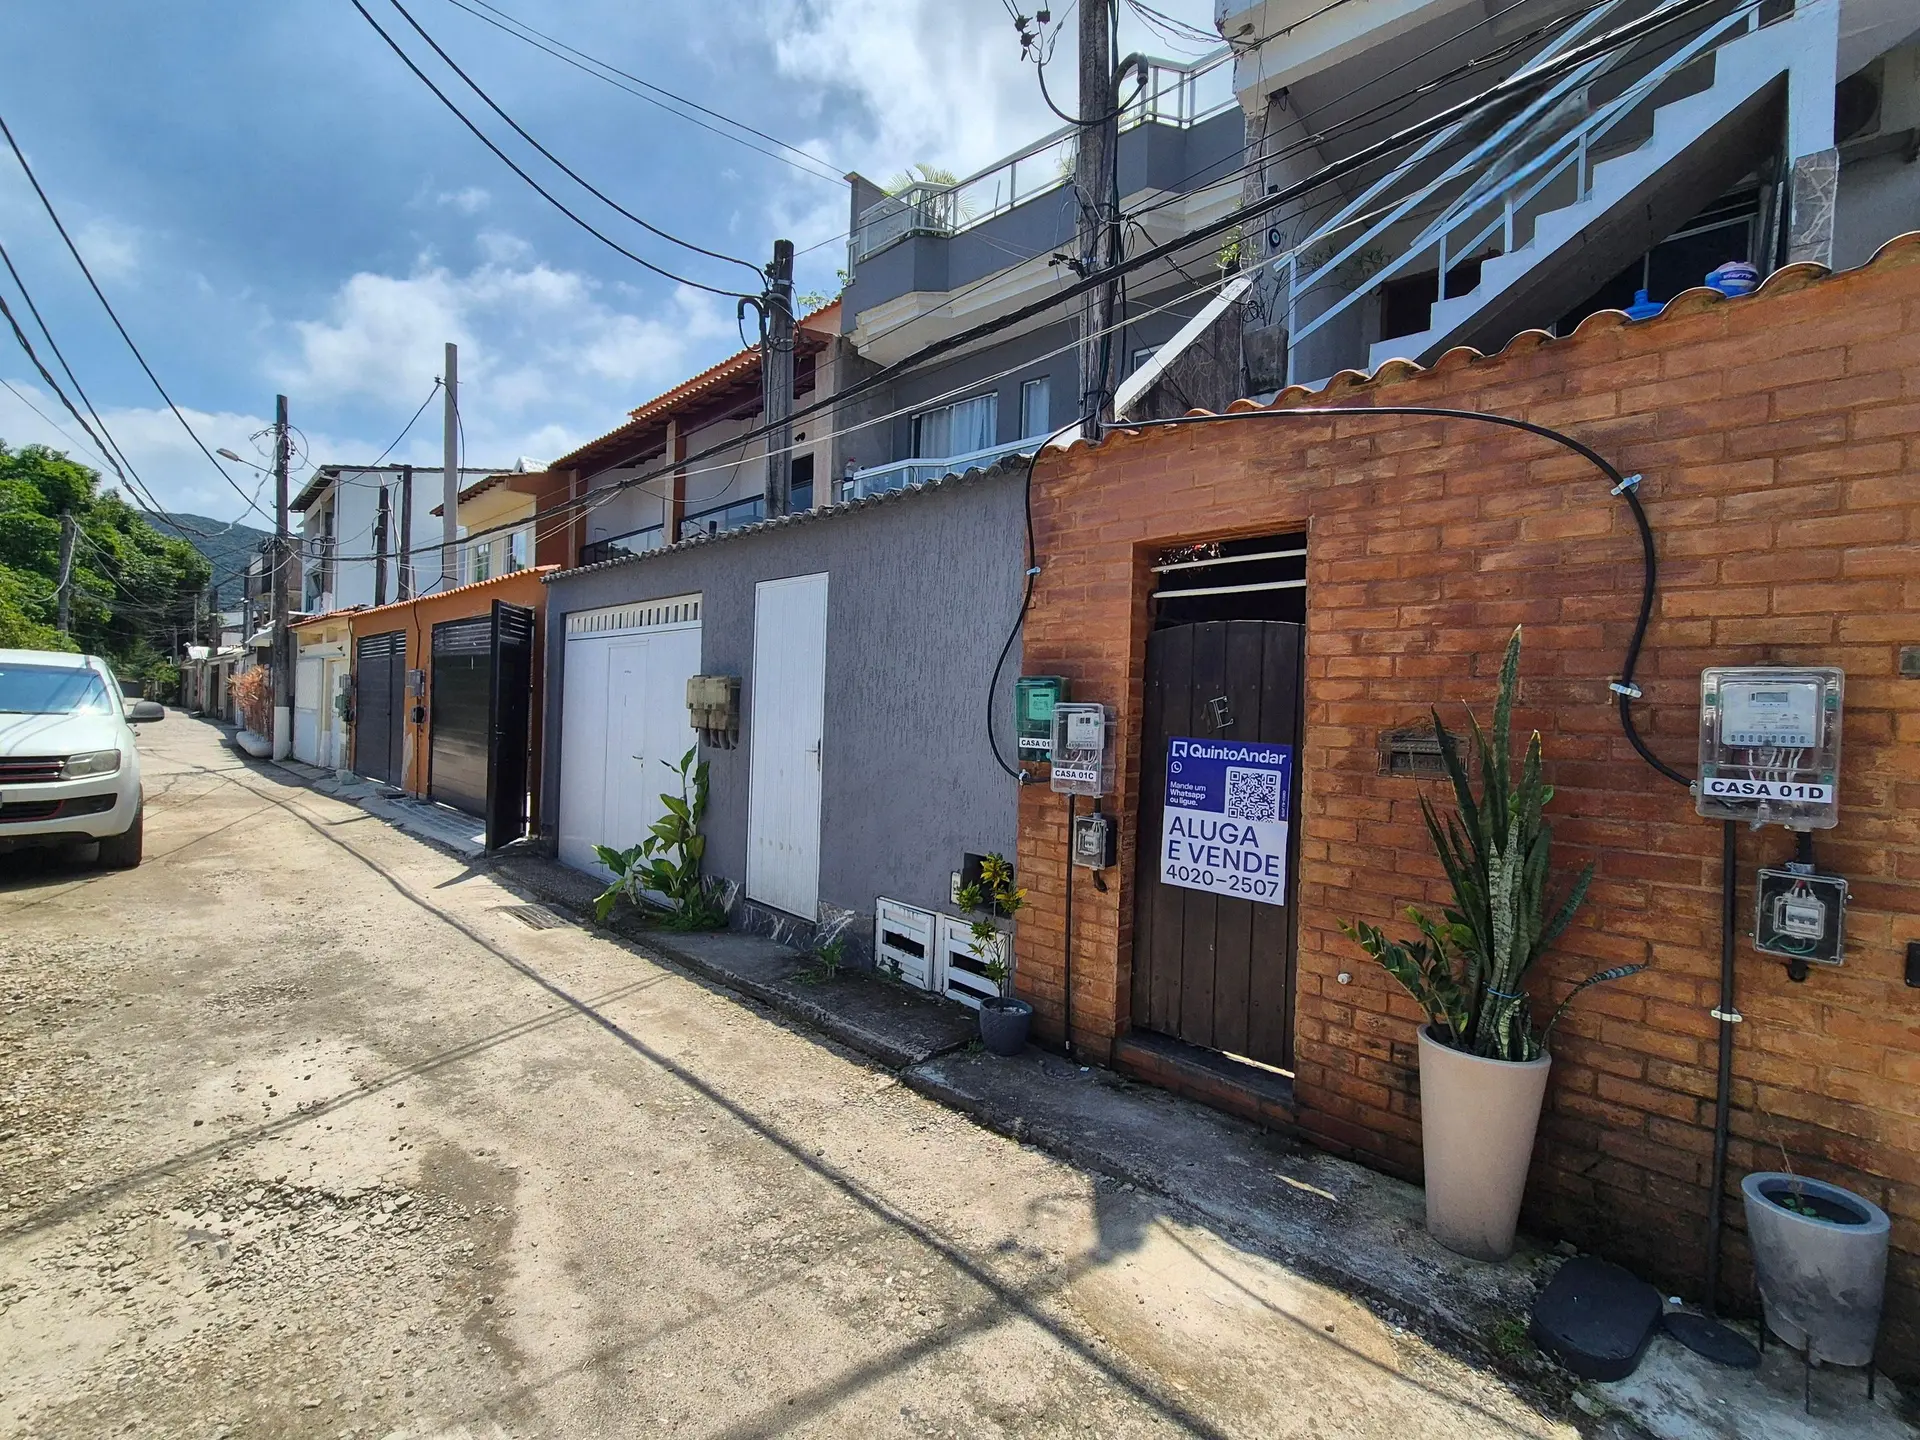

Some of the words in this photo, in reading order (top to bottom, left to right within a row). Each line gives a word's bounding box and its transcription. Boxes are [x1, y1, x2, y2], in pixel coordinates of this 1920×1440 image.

[1021, 739, 1040, 747] CASA
[1190, 744, 1287, 765] QuintoAndar
[1055, 770, 1076, 779] CASA
[1079, 772, 1094, 780] 01C
[1170, 781, 1194, 791] Mande
[1194, 784, 1206, 792] um
[1711, 781, 1771, 796] CASA
[1780, 785, 1824, 799] 01D
[1170, 789, 1206, 800] Whatsapp
[1179, 797, 1198, 807] ligue.
[1169, 816, 1259, 848] ALUGA
[1168, 840, 1181, 861] E
[1188, 843, 1279, 877] VENDE
[1166, 864, 1279, 897] 4020-2507
